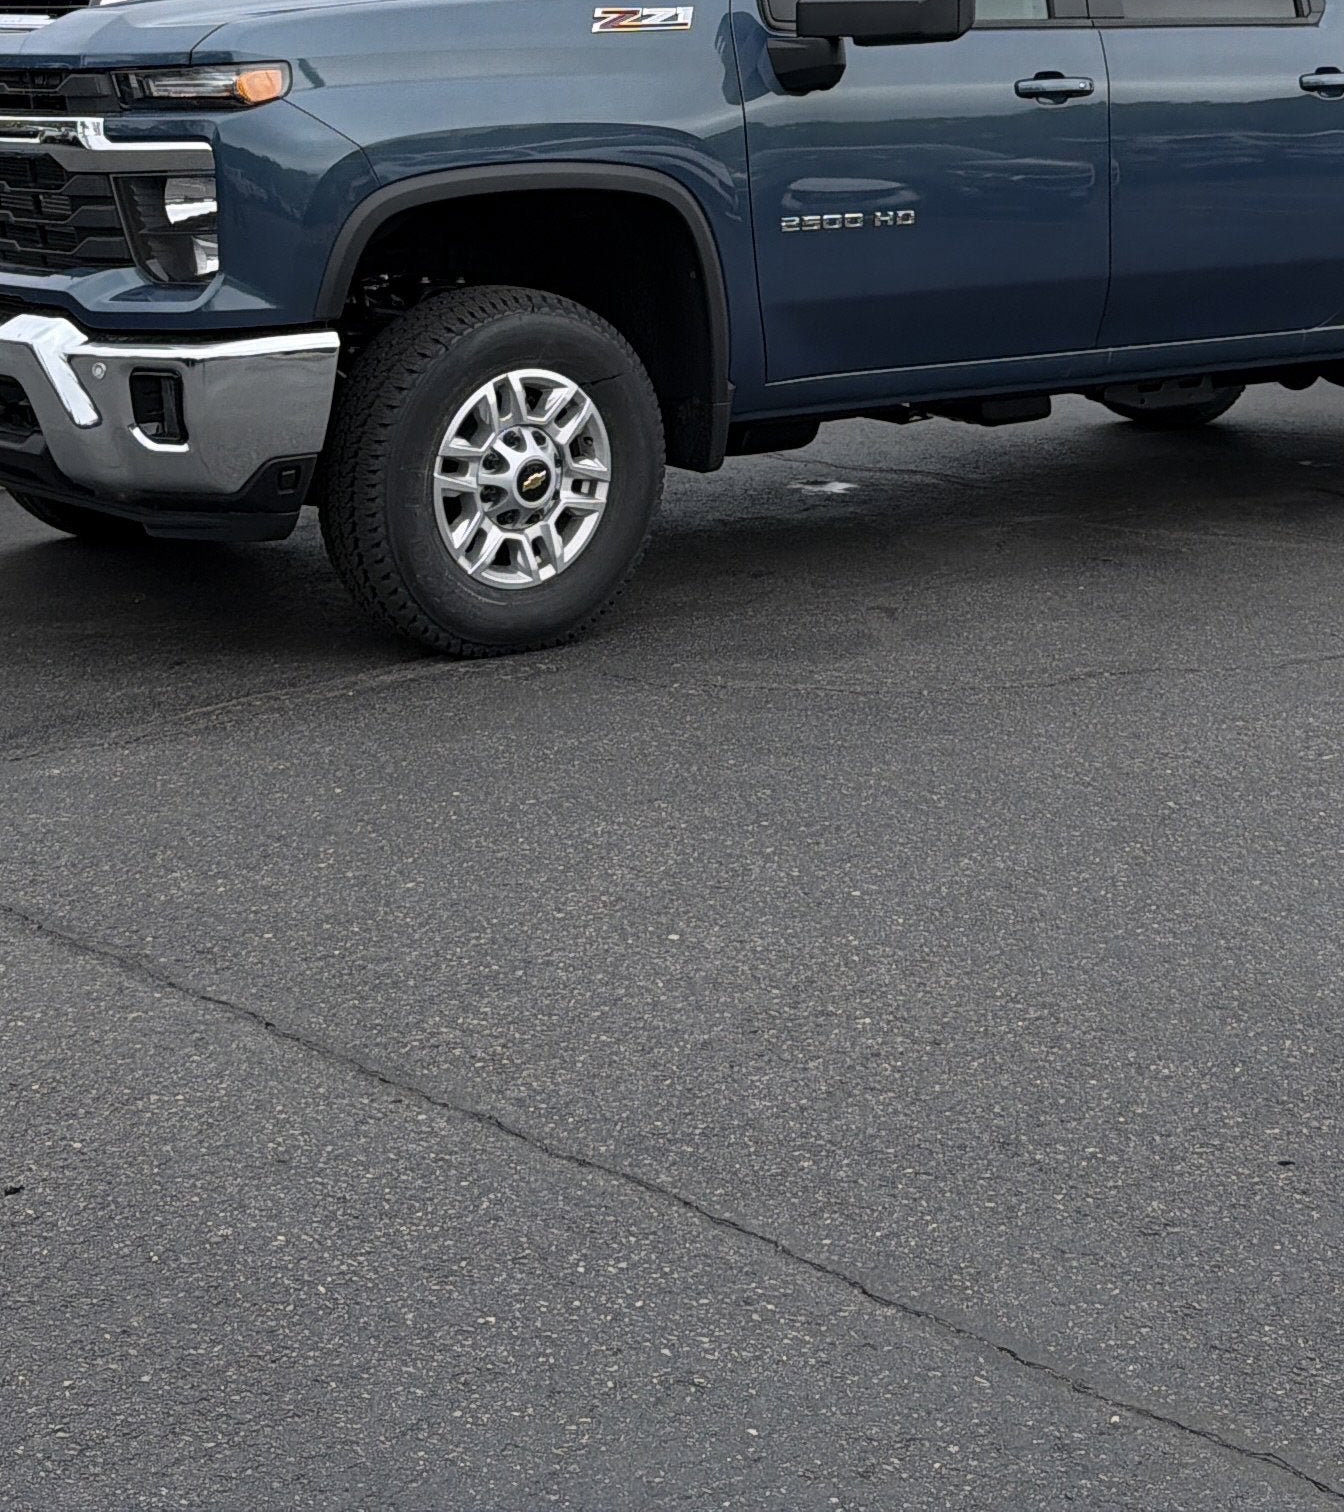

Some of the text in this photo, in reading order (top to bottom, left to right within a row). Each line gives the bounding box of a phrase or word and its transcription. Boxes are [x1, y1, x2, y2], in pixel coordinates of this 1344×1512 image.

[591, 6, 694, 33] Z71
[781, 210, 915, 232] 2500 HD
